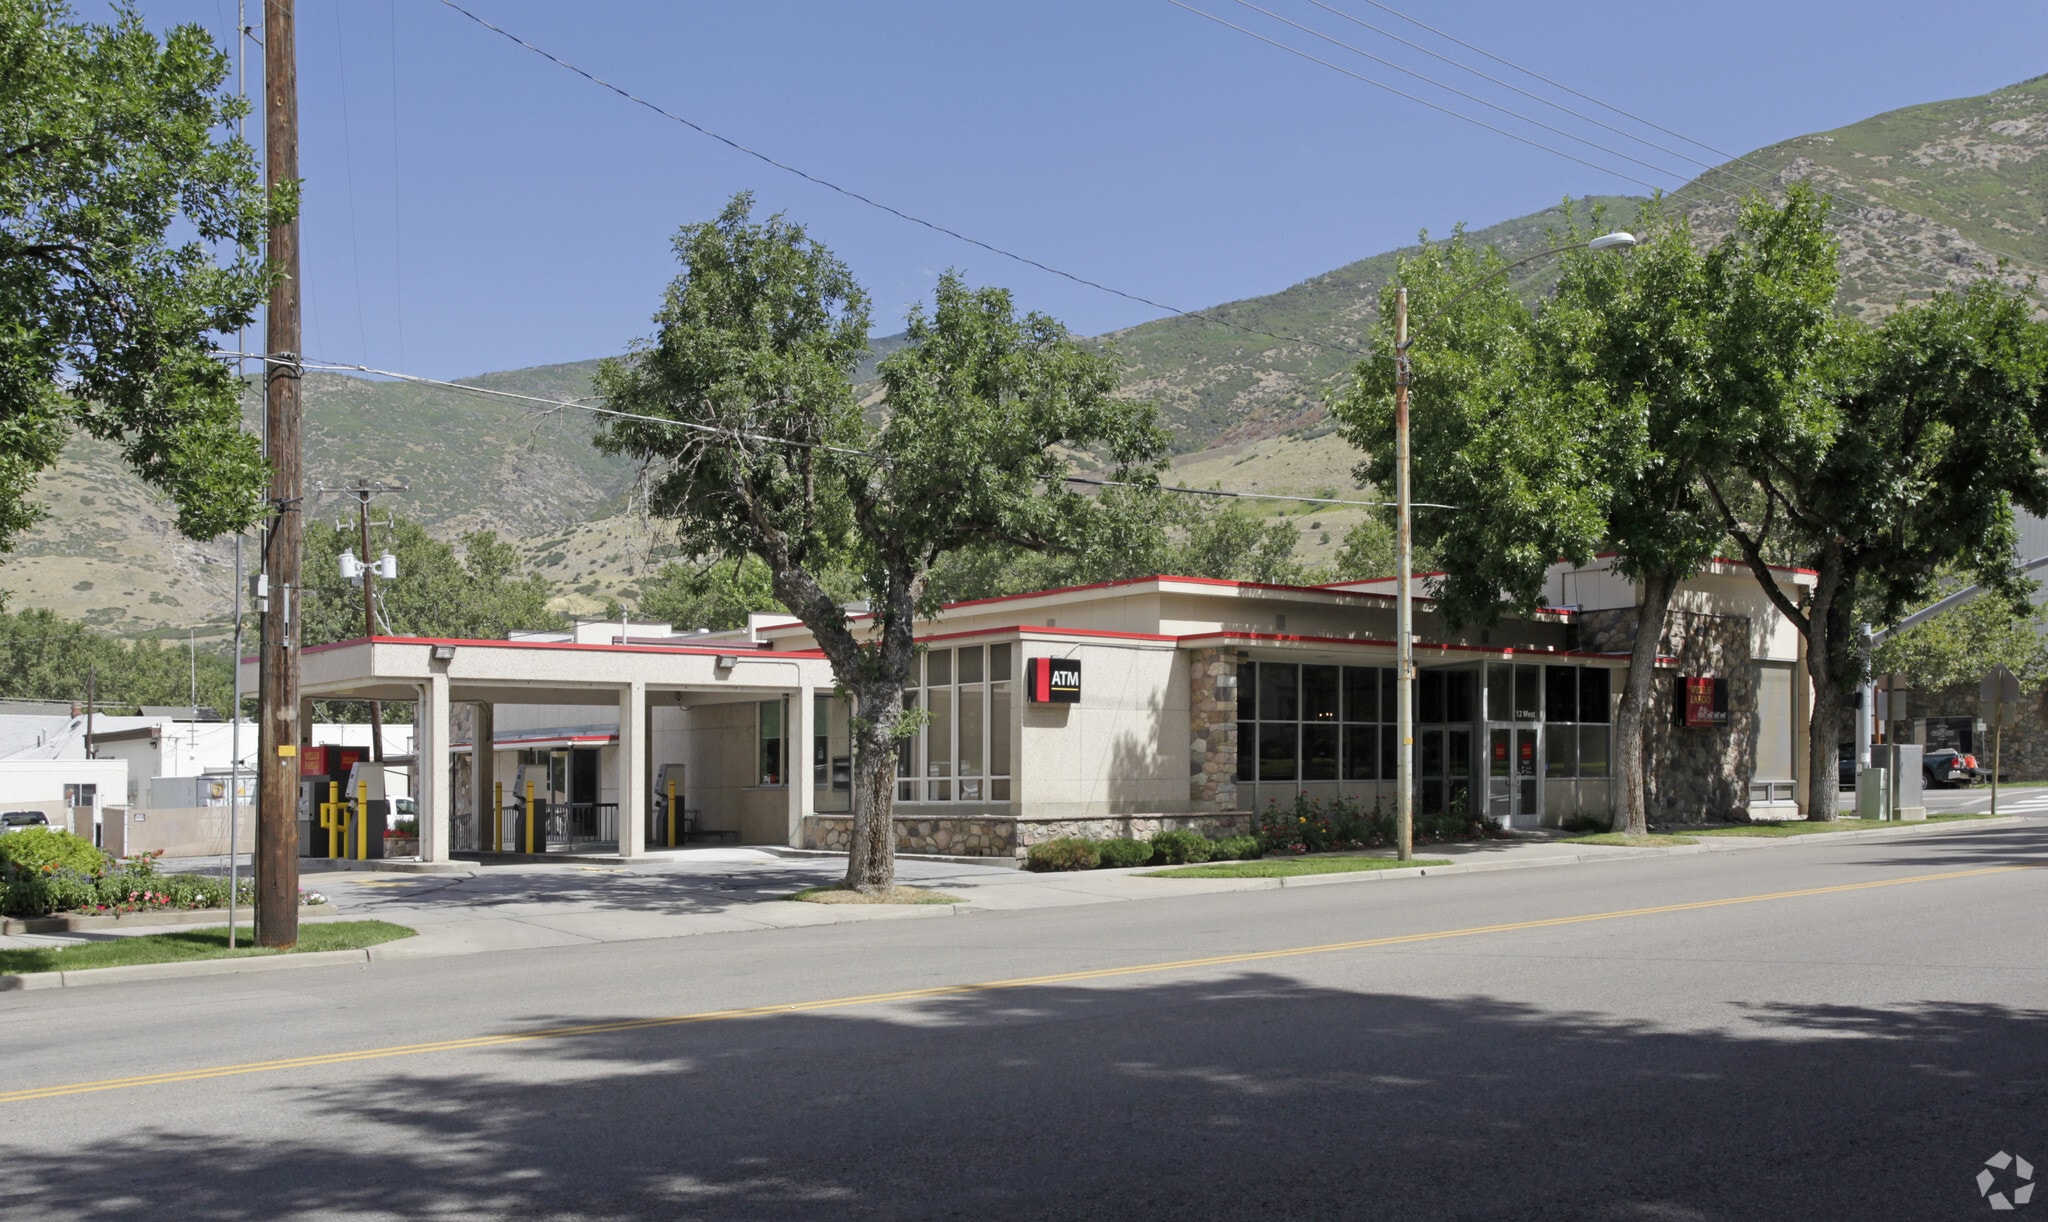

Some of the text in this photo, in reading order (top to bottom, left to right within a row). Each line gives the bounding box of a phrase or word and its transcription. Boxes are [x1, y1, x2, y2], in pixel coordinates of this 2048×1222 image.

[1051, 670, 1079, 686] ATM
[1690, 685, 1711, 694] WELLS
[1690, 695, 1711, 704] FARGO
[1515, 710, 1536, 718] 12 West
[304, 752, 320, 760] WELLS
[304, 761, 320, 770] FARGO
